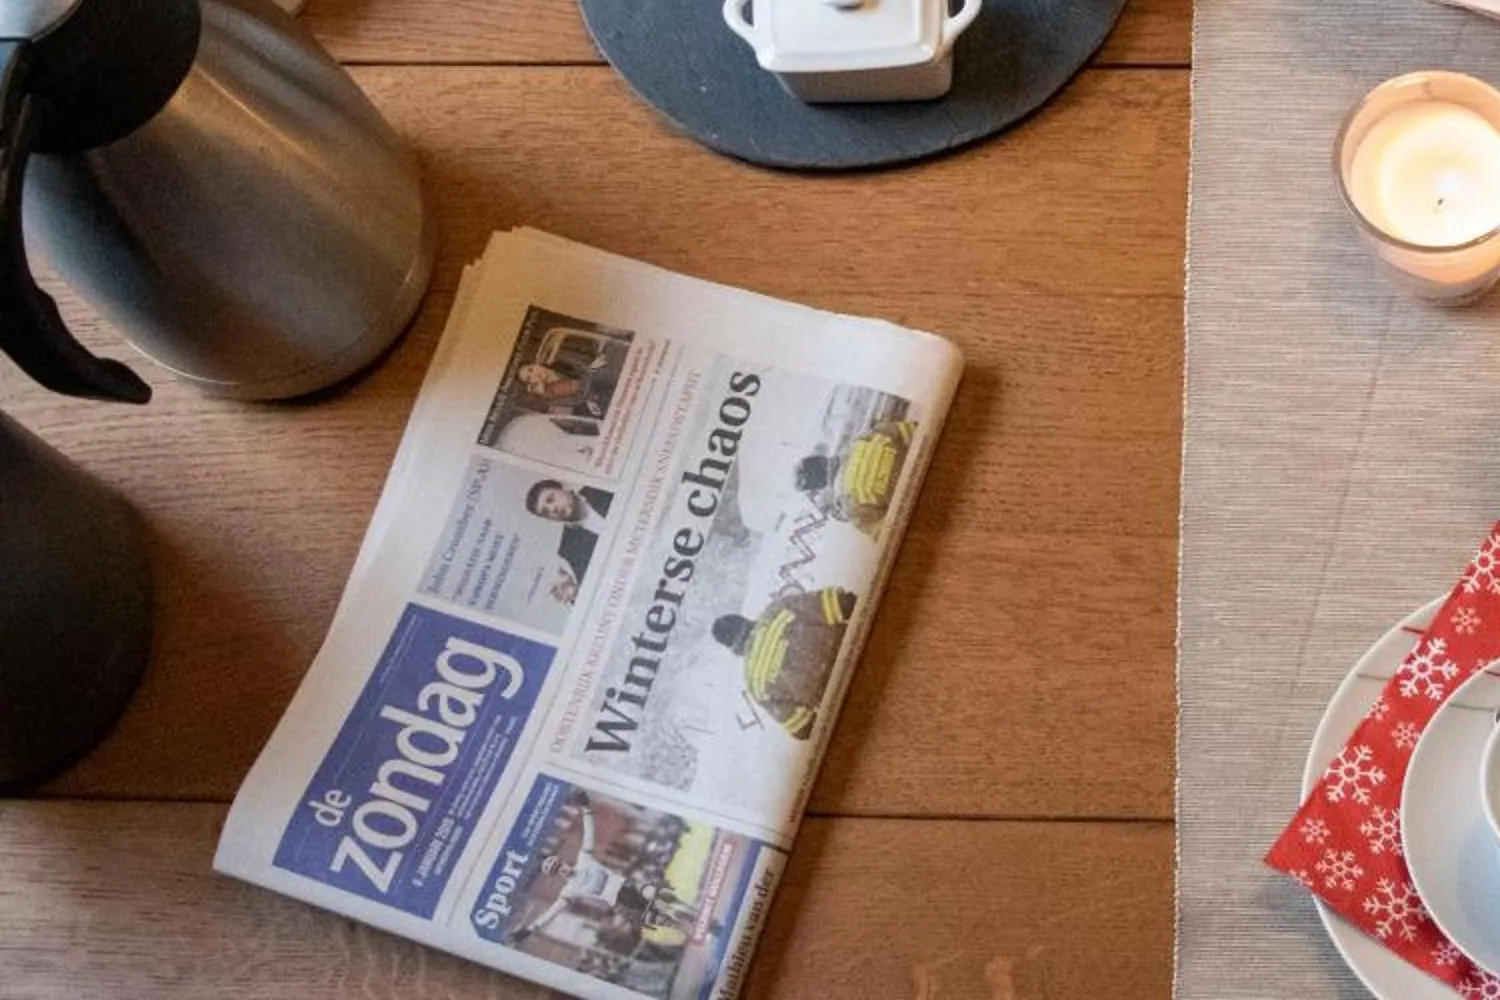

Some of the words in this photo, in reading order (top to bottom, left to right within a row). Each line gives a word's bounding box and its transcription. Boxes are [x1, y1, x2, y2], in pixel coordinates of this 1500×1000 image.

[583, 523, 706, 749] Winterse
[681, 365, 764, 521] chaos
[308, 787, 352, 828] de
[329, 635, 523, 893] zondag
[474, 848, 529, 931] Sport
